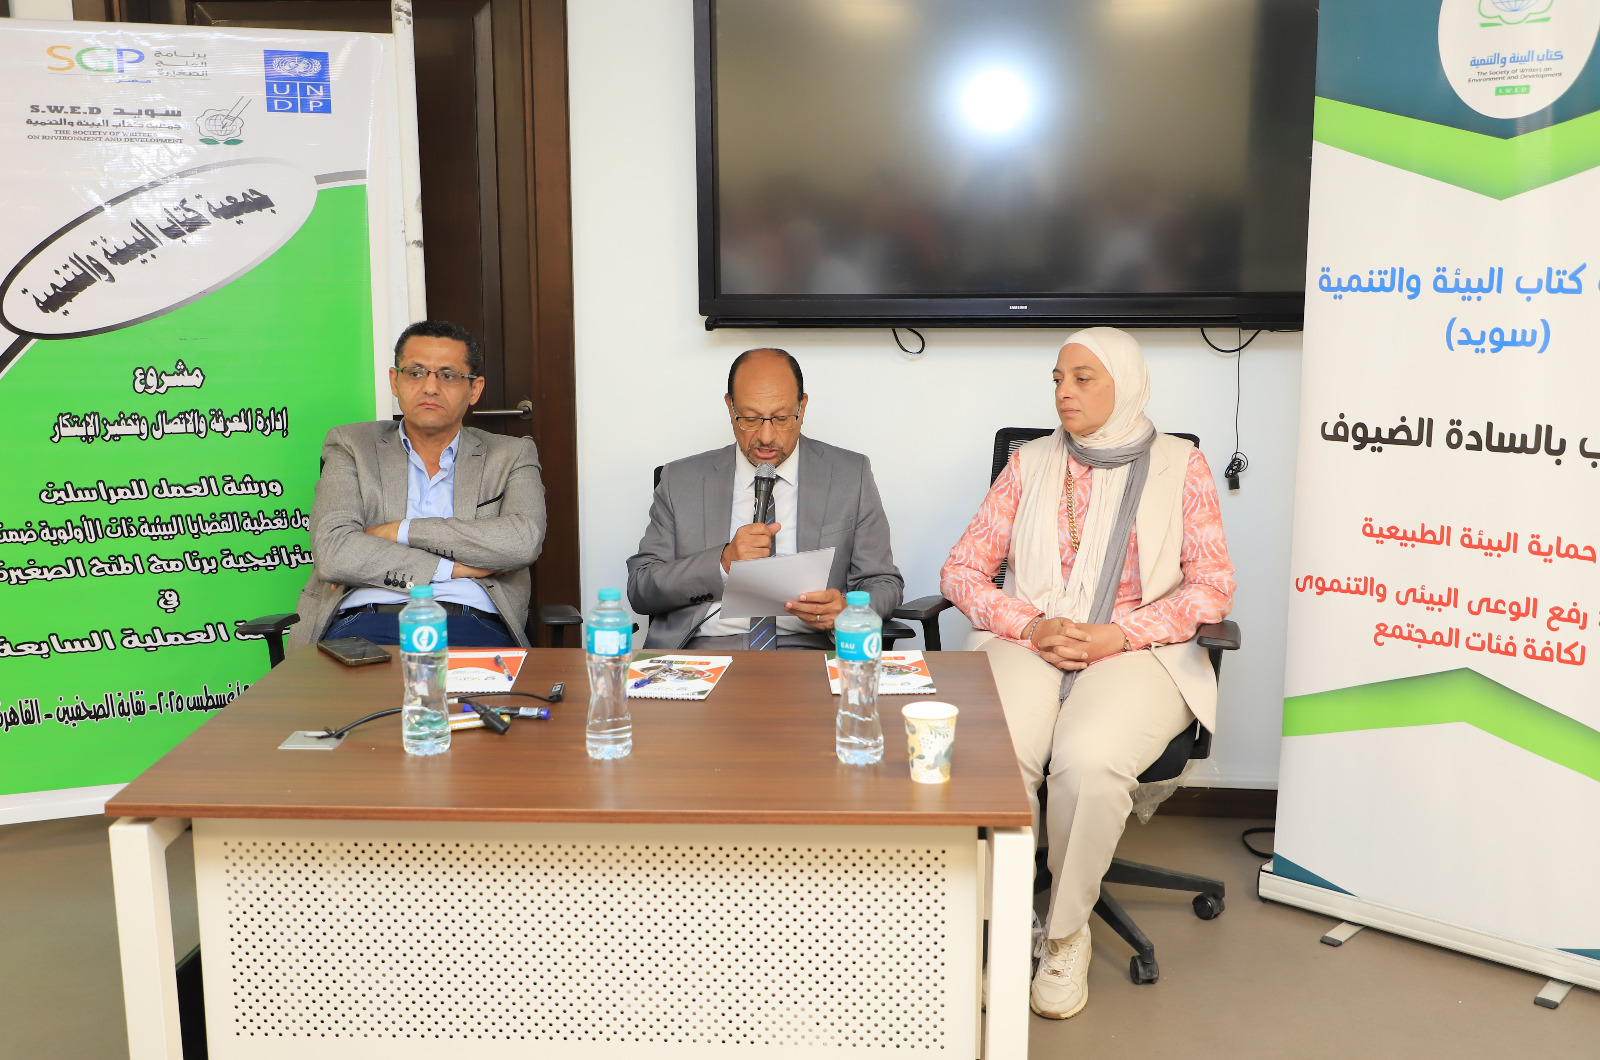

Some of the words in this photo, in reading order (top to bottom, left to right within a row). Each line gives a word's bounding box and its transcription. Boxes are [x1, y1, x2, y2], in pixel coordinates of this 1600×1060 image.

[46, 45, 145, 73] SGP
[154, 50, 207, 60] برنامج
[1470, 53, 1507, 68] والتنمية
[1537, 49, 1563, 63] كتاب
[26, 118, 75, 127] والتنمية
[30, 104, 102, 115] S.W.E.D
[113, 106, 182, 118] سويد
[156, 198, 212, 244] كتاب
[195, 189, 275, 225] جمعية
[92, 219, 164, 266] البيئة
[20, 252, 116, 316] والتنمية
[1318, 266, 1422, 300] والتنمية
[1432, 266, 1504, 301] البيئة
[1515, 262, 1587, 302] كتاب
[1445, 316, 1551, 354] (سويد)
[132, 359, 206, 394] مشروع
[101, 411, 149, 442] وتحفيز
[151, 409, 208, 440] والاتصال
[208, 407, 252, 438] المعرفة
[255, 406, 289, 438] إدارة
[1320, 412, 1434, 454] الضيوف
[1445, 418, 1567, 466] بالسادة
[40, 478, 150, 505] للمراسلين
[152, 476, 220, 500] العمل
[222, 474, 284, 497] ورشة
[38, 514, 104, 546] الأولوية
[105, 516, 137, 538] ذات
[139, 515, 185, 540] البيئية
[186, 511, 240, 539] القضايا
[241, 509, 289, 535] تغطية
[290, 508, 310, 531] ول
[1361, 516, 1452, 548] الطبيعية
[1459, 527, 1519, 558] البيئة
[1527, 533, 1597, 564] حماية
[0, 556, 87, 585] الصغيرة
[89, 553, 144, 578] المنح
[148, 551, 218, 575] برنامج
[221, 544, 314, 572] ستراتيجية
[156, 587, 180, 614] في
[1295, 574, 1387, 603] والتنموى
[1395, 584, 1459, 612] البيئى
[1467, 596, 1538, 622] الوعى
[1546, 601, 1588, 632] رفع
[0, 629, 116, 659] السابعة
[120, 621, 230, 652] العملية
[1373, 621, 1460, 649] المجتمع
[1465, 631, 1517, 658] فئات
[1523, 638, 1586, 666] لكافة
[55, 692, 115, 728] الصحفيين
[117, 690, 147, 722] نقابة
